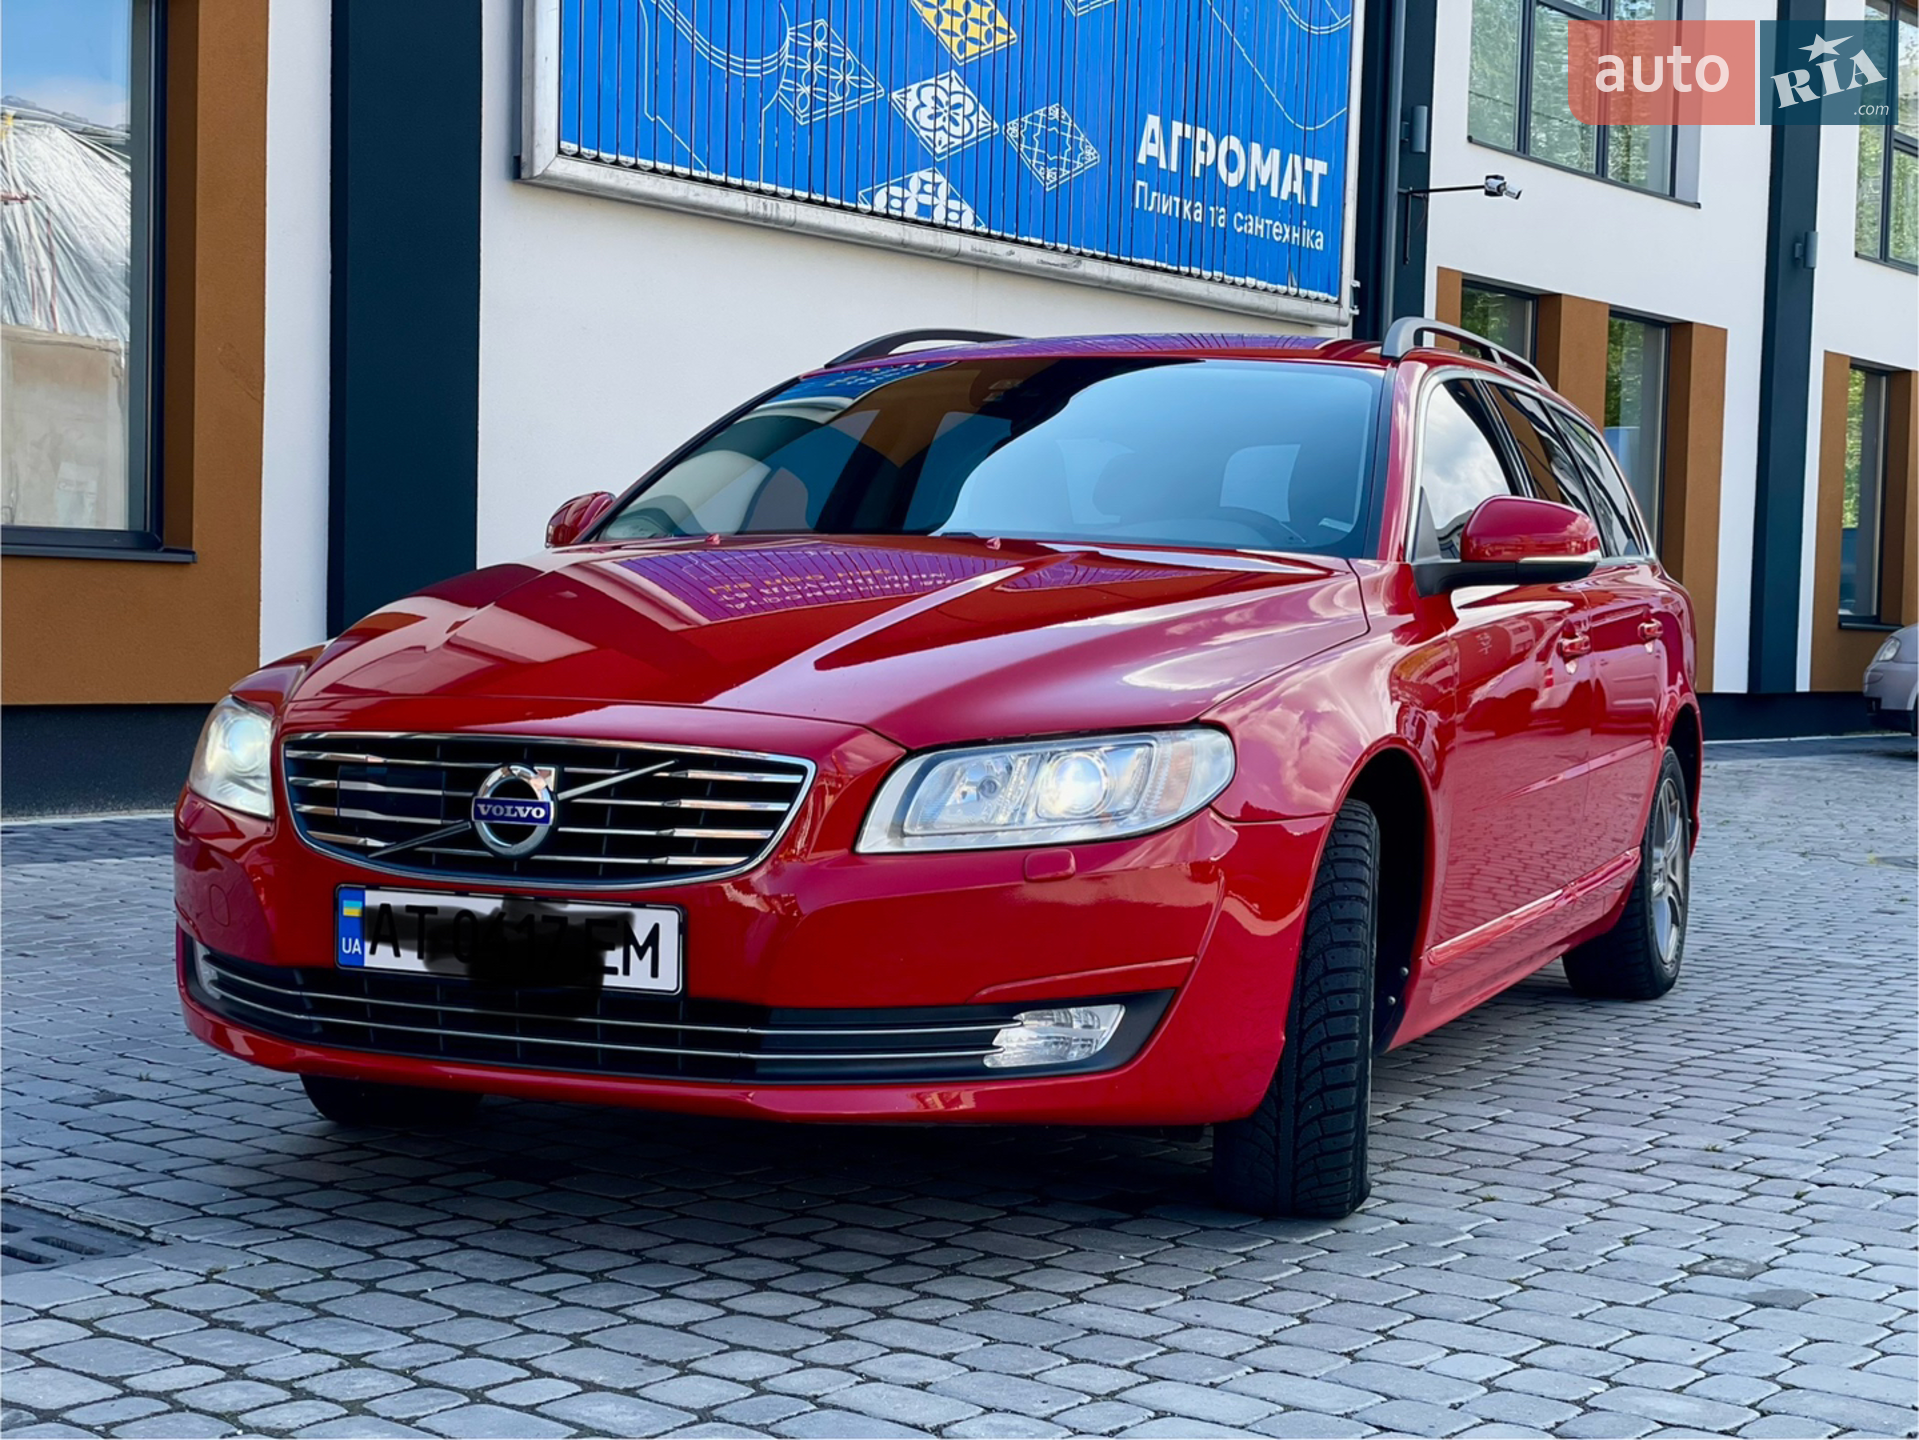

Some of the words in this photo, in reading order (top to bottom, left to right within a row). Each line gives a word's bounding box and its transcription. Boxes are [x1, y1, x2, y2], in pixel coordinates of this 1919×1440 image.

[1136, 113, 1328, 208] АГРОМАТ
[1134, 179, 1203, 223] Плитка
[1209, 204, 1227, 229] та
[1233, 211, 1325, 251] сантехніка
[476, 803, 546, 819] VOLVO
[341, 937, 363, 955] UA
[368, 902, 439, 961] AT
